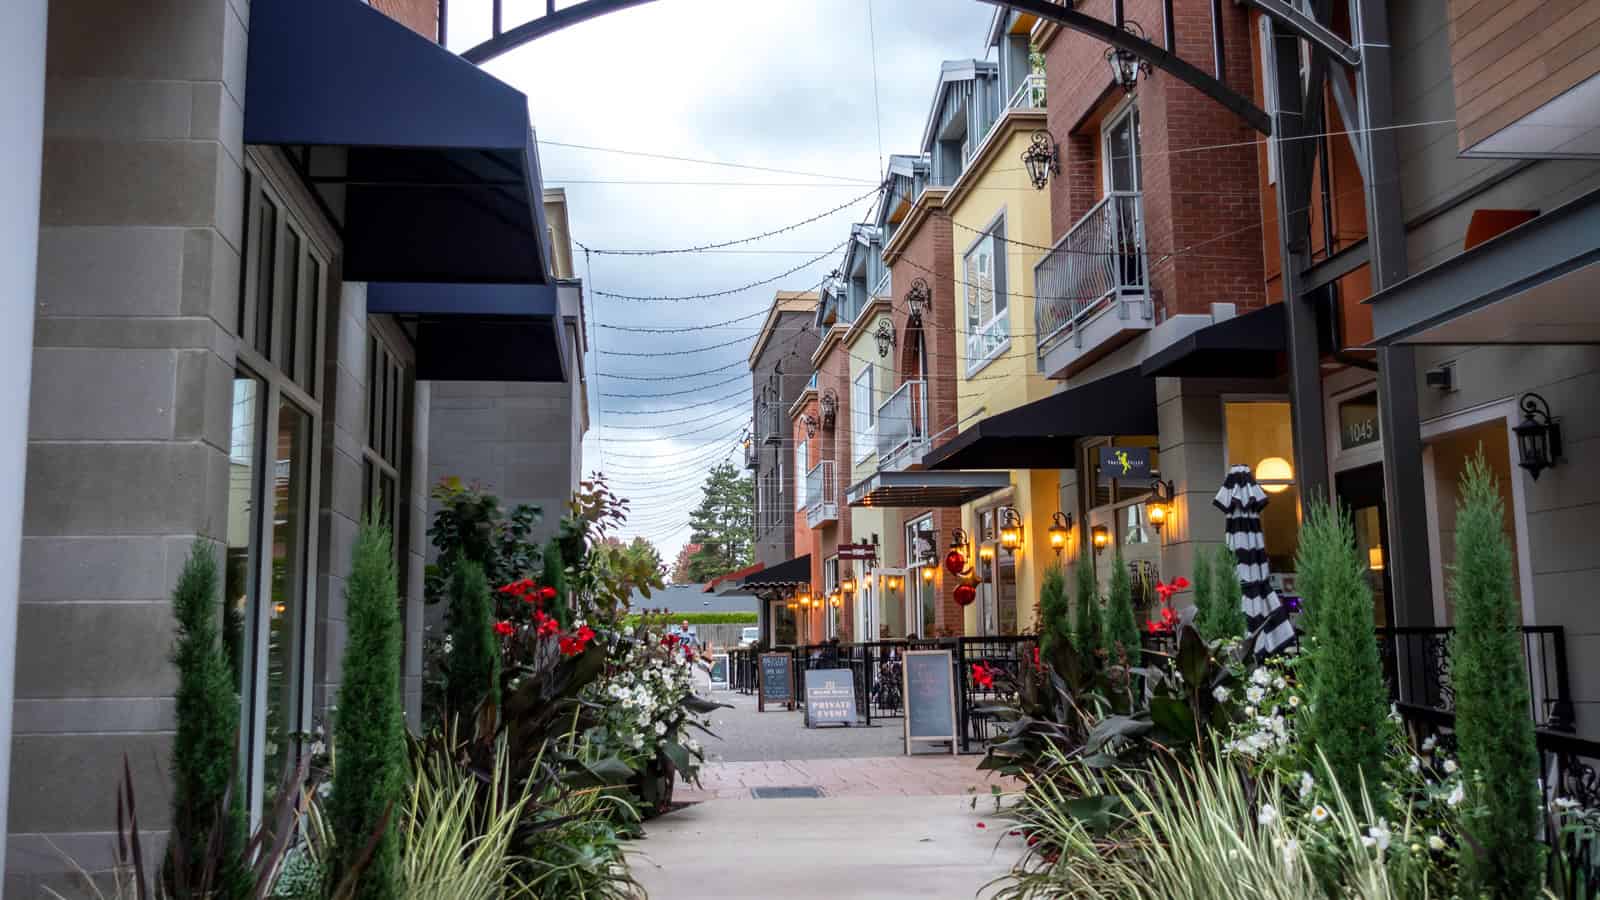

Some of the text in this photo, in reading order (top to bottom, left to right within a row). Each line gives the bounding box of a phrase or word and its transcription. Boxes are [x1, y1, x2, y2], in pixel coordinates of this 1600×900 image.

[1350, 419, 1373, 442] 1045
[812, 701, 849, 710] PRIVATE
[816, 710, 848, 718] EVENT
